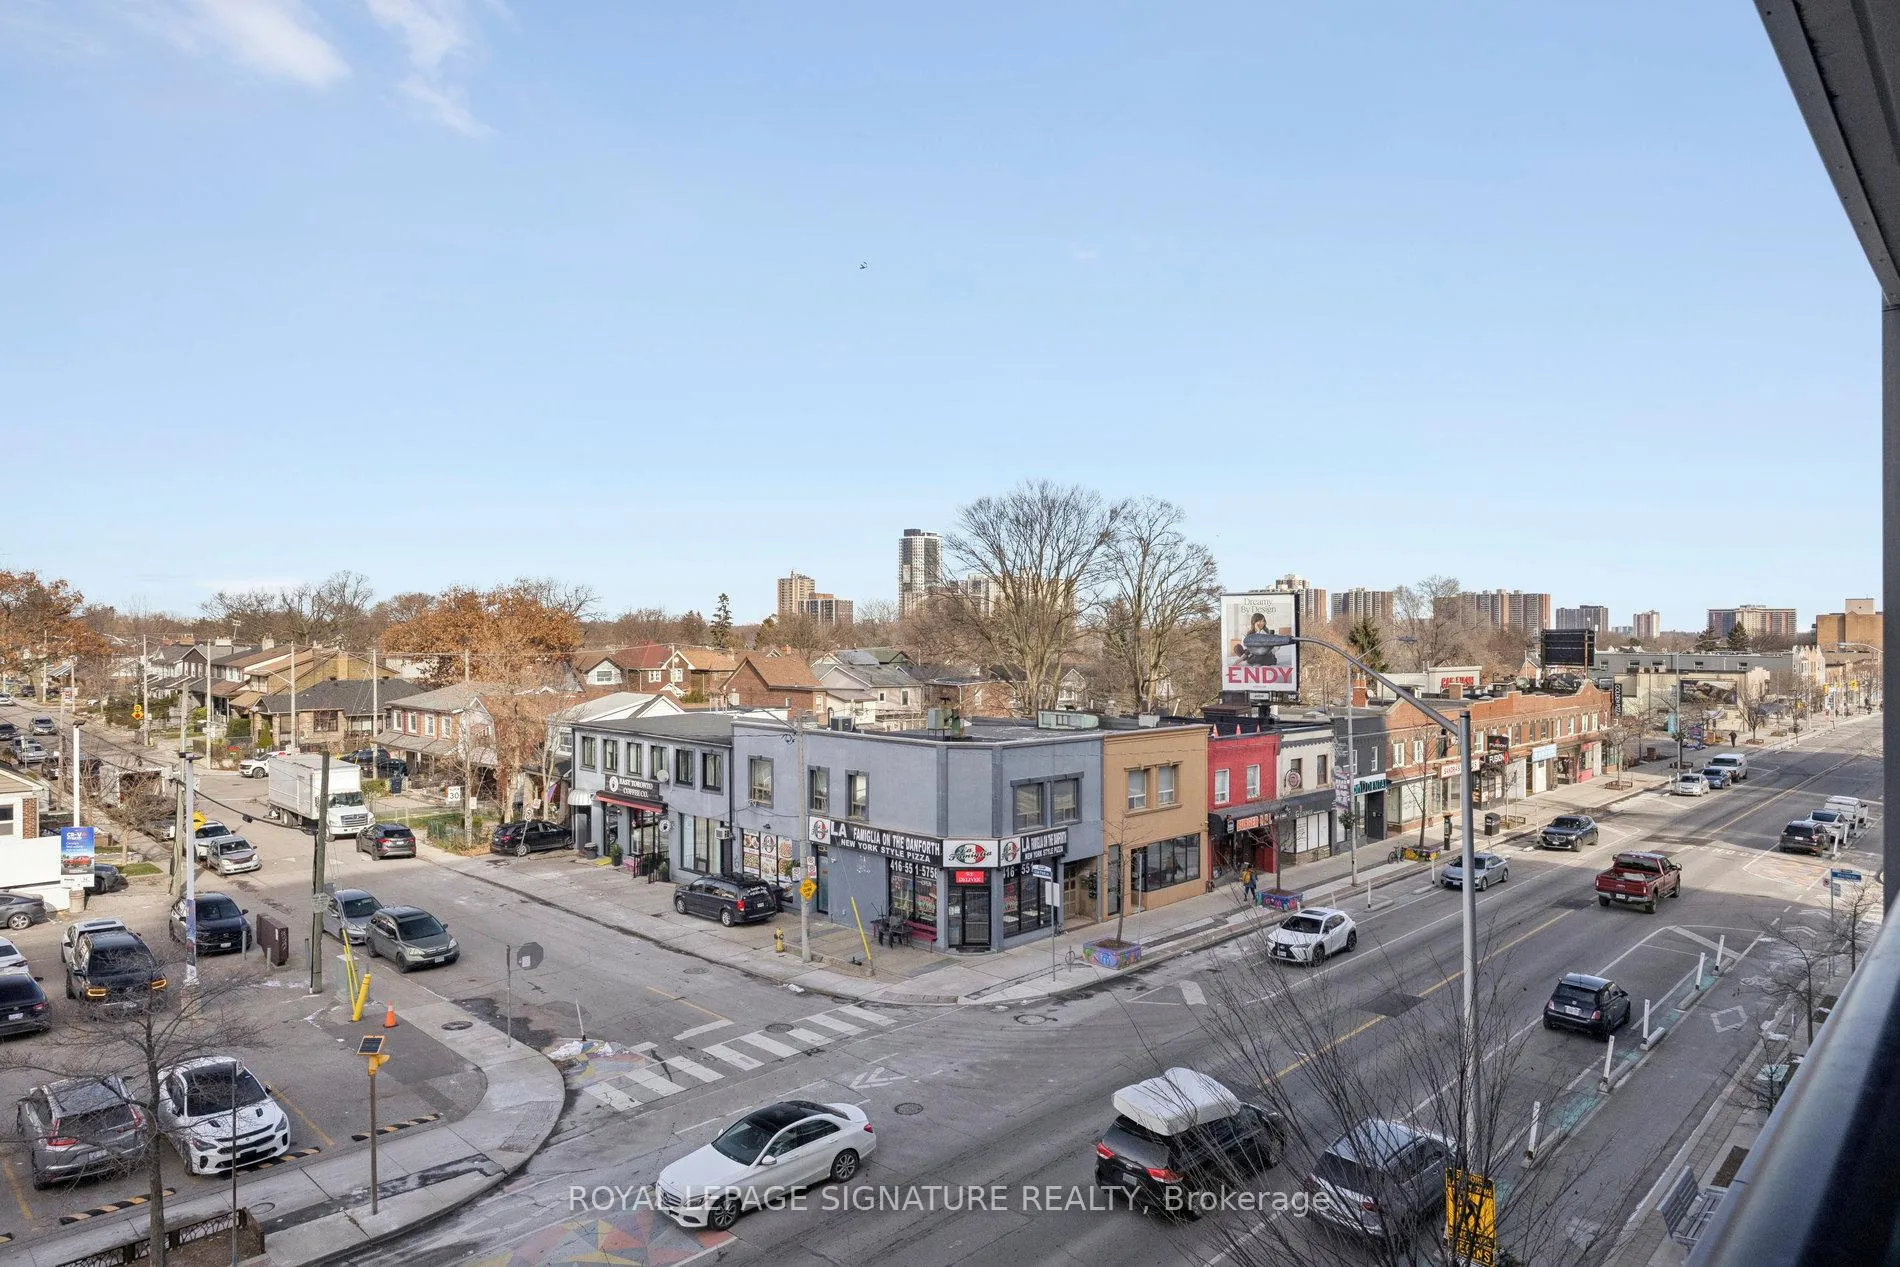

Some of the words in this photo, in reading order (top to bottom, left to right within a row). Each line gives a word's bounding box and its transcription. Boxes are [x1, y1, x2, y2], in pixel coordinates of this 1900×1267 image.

[1244, 598, 1273, 606] Dreamy
[1241, 606, 1249, 614] By
[1251, 606, 1277, 614] Design
[1226, 666, 1294, 684] ENDY
[619, 778, 630, 786] EAST
[631, 780, 654, 790] TORONTO
[623, 787, 640, 797] COFFEE
[830, 821, 847, 837] LA
[853, 828, 881, 844] FAMIGLIA
[882, 832, 891, 846] ON
[892, 834, 904, 850] THE
[905, 837, 940, 856] DANFORTH
[1021, 836, 1030, 852] LA
[841, 839, 855, 848] NEW
[858, 842, 878, 852] YORK
[880, 846, 904, 858] STYLE
[907, 852, 931, 863] PIZZA
[948, 849, 992, 861] Famiglia
